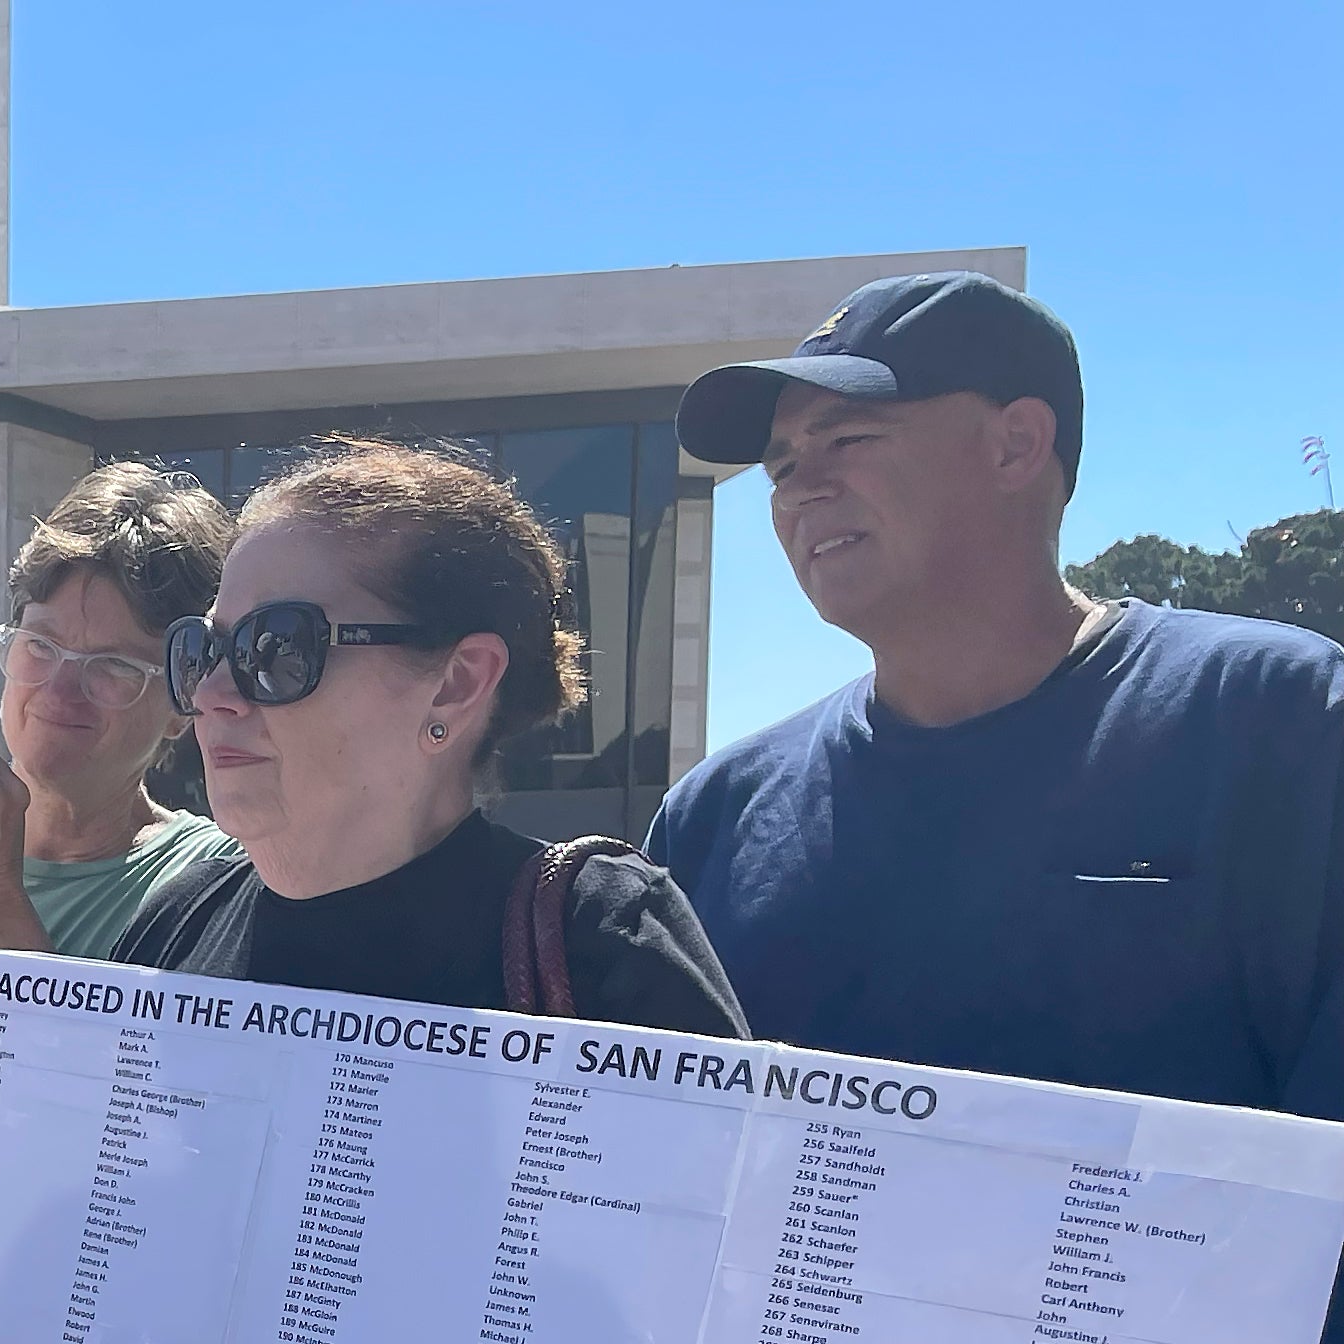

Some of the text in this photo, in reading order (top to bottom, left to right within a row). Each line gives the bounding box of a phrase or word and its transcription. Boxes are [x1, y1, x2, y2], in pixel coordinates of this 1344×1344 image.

[120, 1028, 147, 1039] Arthur
[131, 988, 163, 1020] IN
[174, 996, 231, 1029] THE
[241, 1002, 489, 1060] ARCHDIOCESE
[501, 1032, 555, 1065] OF
[575, 1039, 662, 1081] SAN
[673, 1051, 937, 1120] FRANCISCO
[335, 1052, 394, 1070] 170 Mancuso
[332, 1067, 390, 1084] 171 Manville
[534, 1081, 580, 1097] Sylvester
[531, 1096, 583, 1113] Alexander
[528, 1112, 567, 1126] Edward
[806, 1122, 861, 1140] 255 Ryan
[101, 1137, 127, 1150] Patrick
[803, 1138, 876, 1158] 256 Saalfeld
[799, 1154, 885, 1177] 257 Sandholdt
[1071, 1163, 1132, 1181] Frederick
[1068, 1179, 1115, 1196] Charles
[1064, 1196, 1120, 1213] Christian
[1055, 1228, 1109, 1246] Stephen
[1060, 1211, 1121, 1231] Lawrence
[1145, 1225, 1206, 1246] (Brother)
